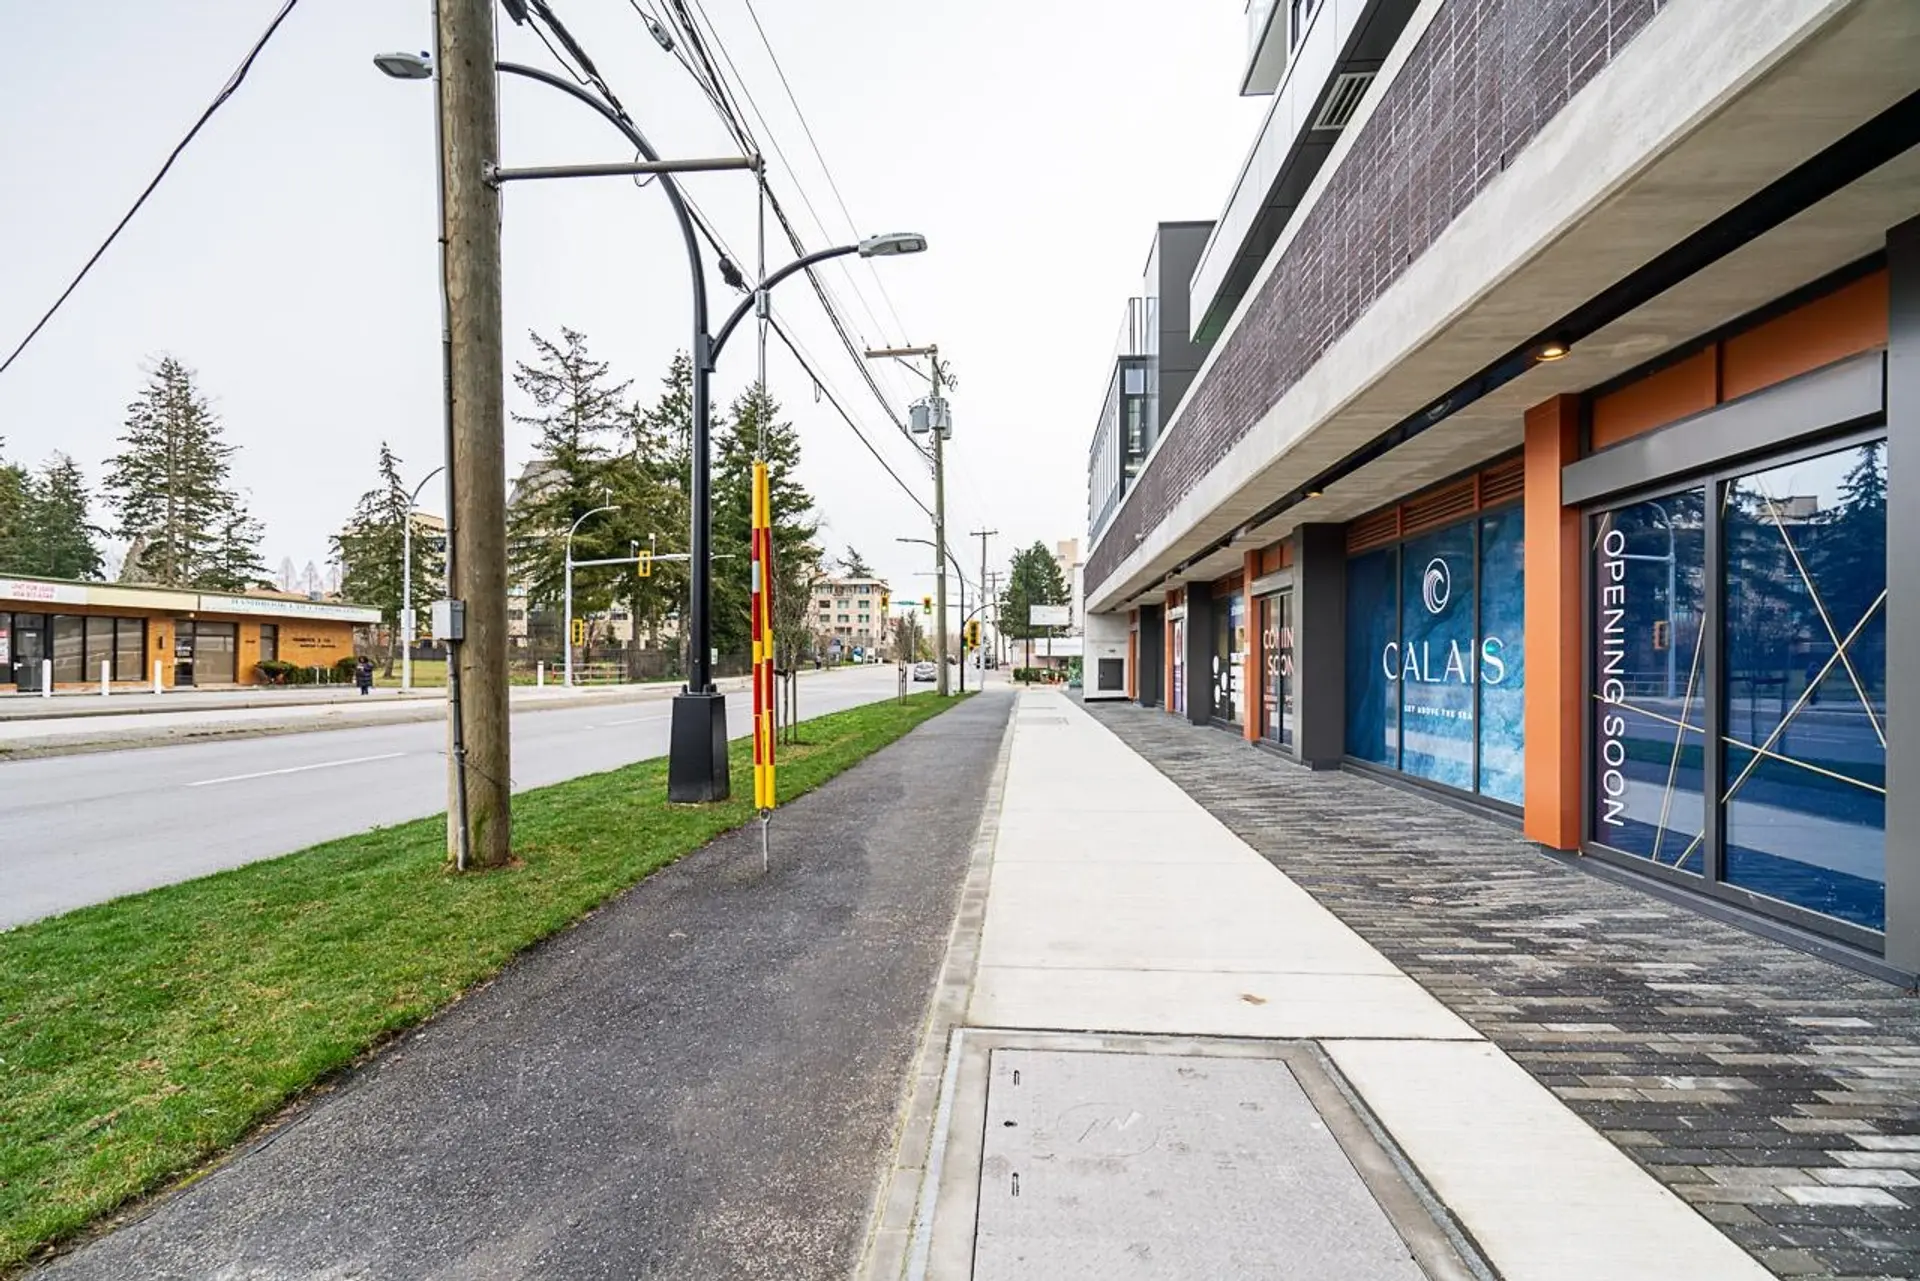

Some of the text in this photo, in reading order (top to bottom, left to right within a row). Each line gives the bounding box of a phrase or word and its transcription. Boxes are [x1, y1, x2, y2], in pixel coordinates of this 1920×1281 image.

[1263, 627, 1295, 650] COMIN
[1382, 637, 1505, 685] CALAIS
[1603, 530, 1625, 826] OPENING SOON
